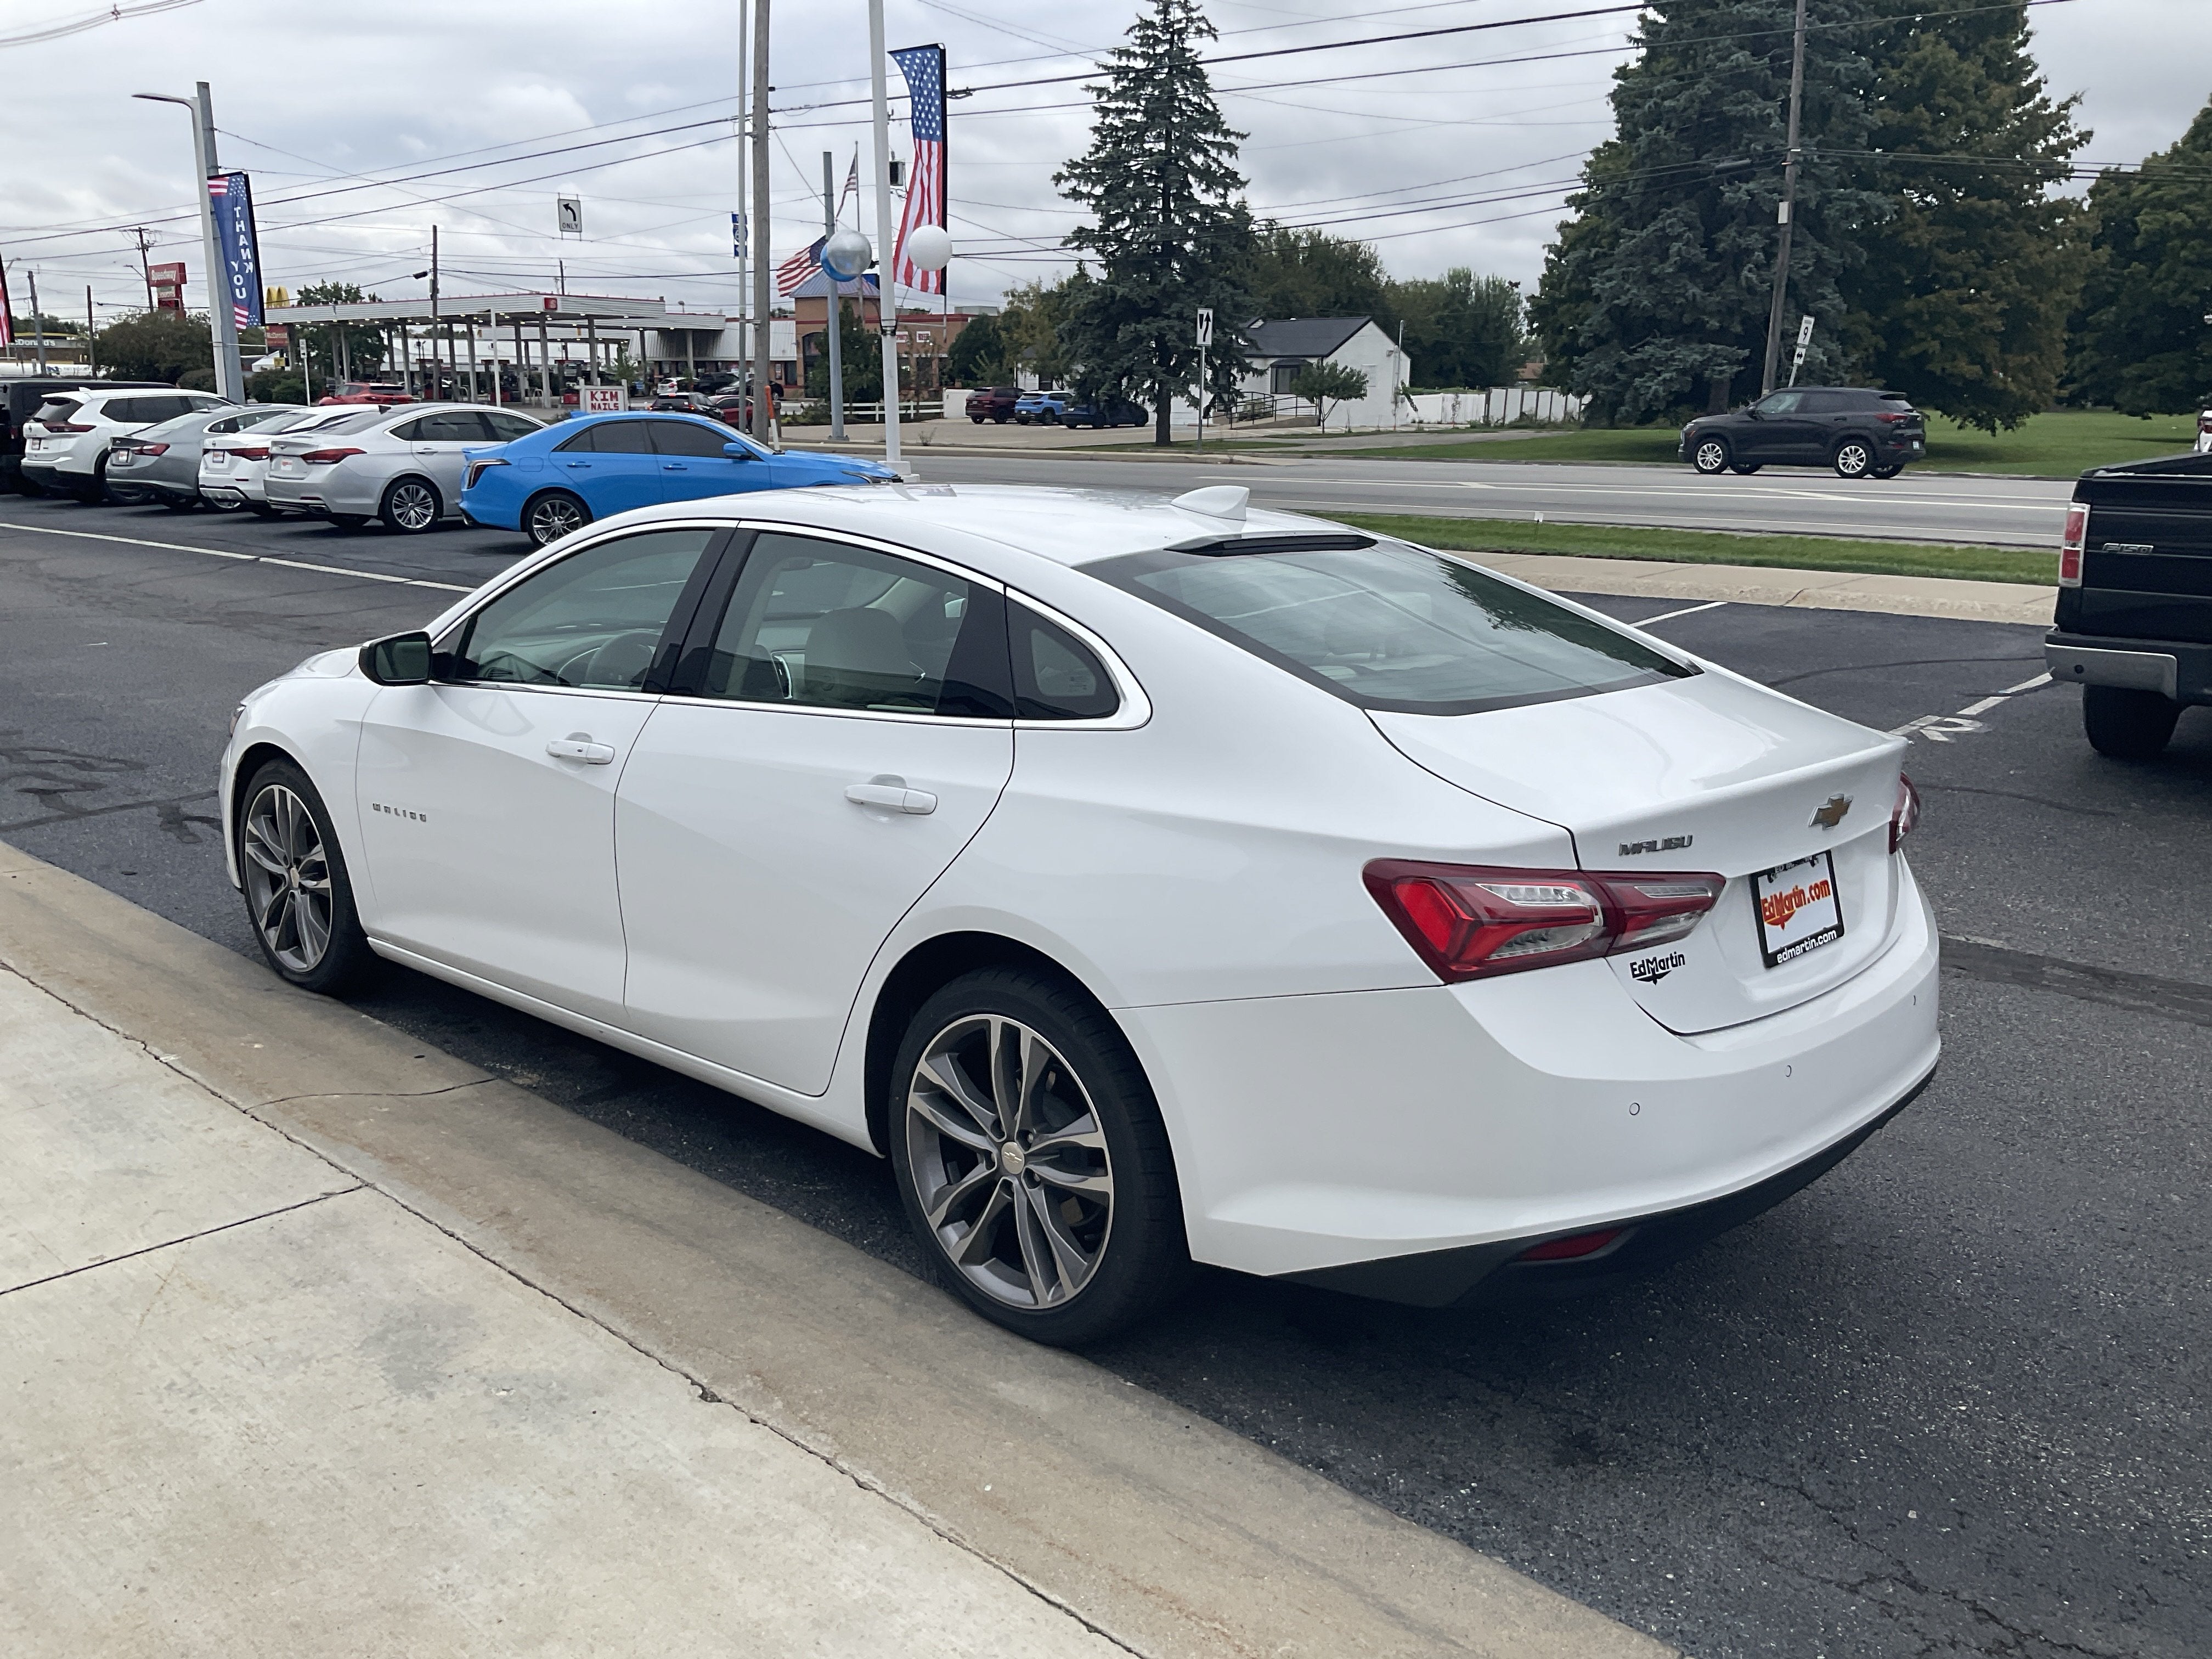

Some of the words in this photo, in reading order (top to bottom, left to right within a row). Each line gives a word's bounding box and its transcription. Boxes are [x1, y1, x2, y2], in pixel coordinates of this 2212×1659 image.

[590, 391, 618, 401] KIM
[1618, 834, 1693, 856] MALIBU
[1777, 929, 1837, 963] edmartin.com
